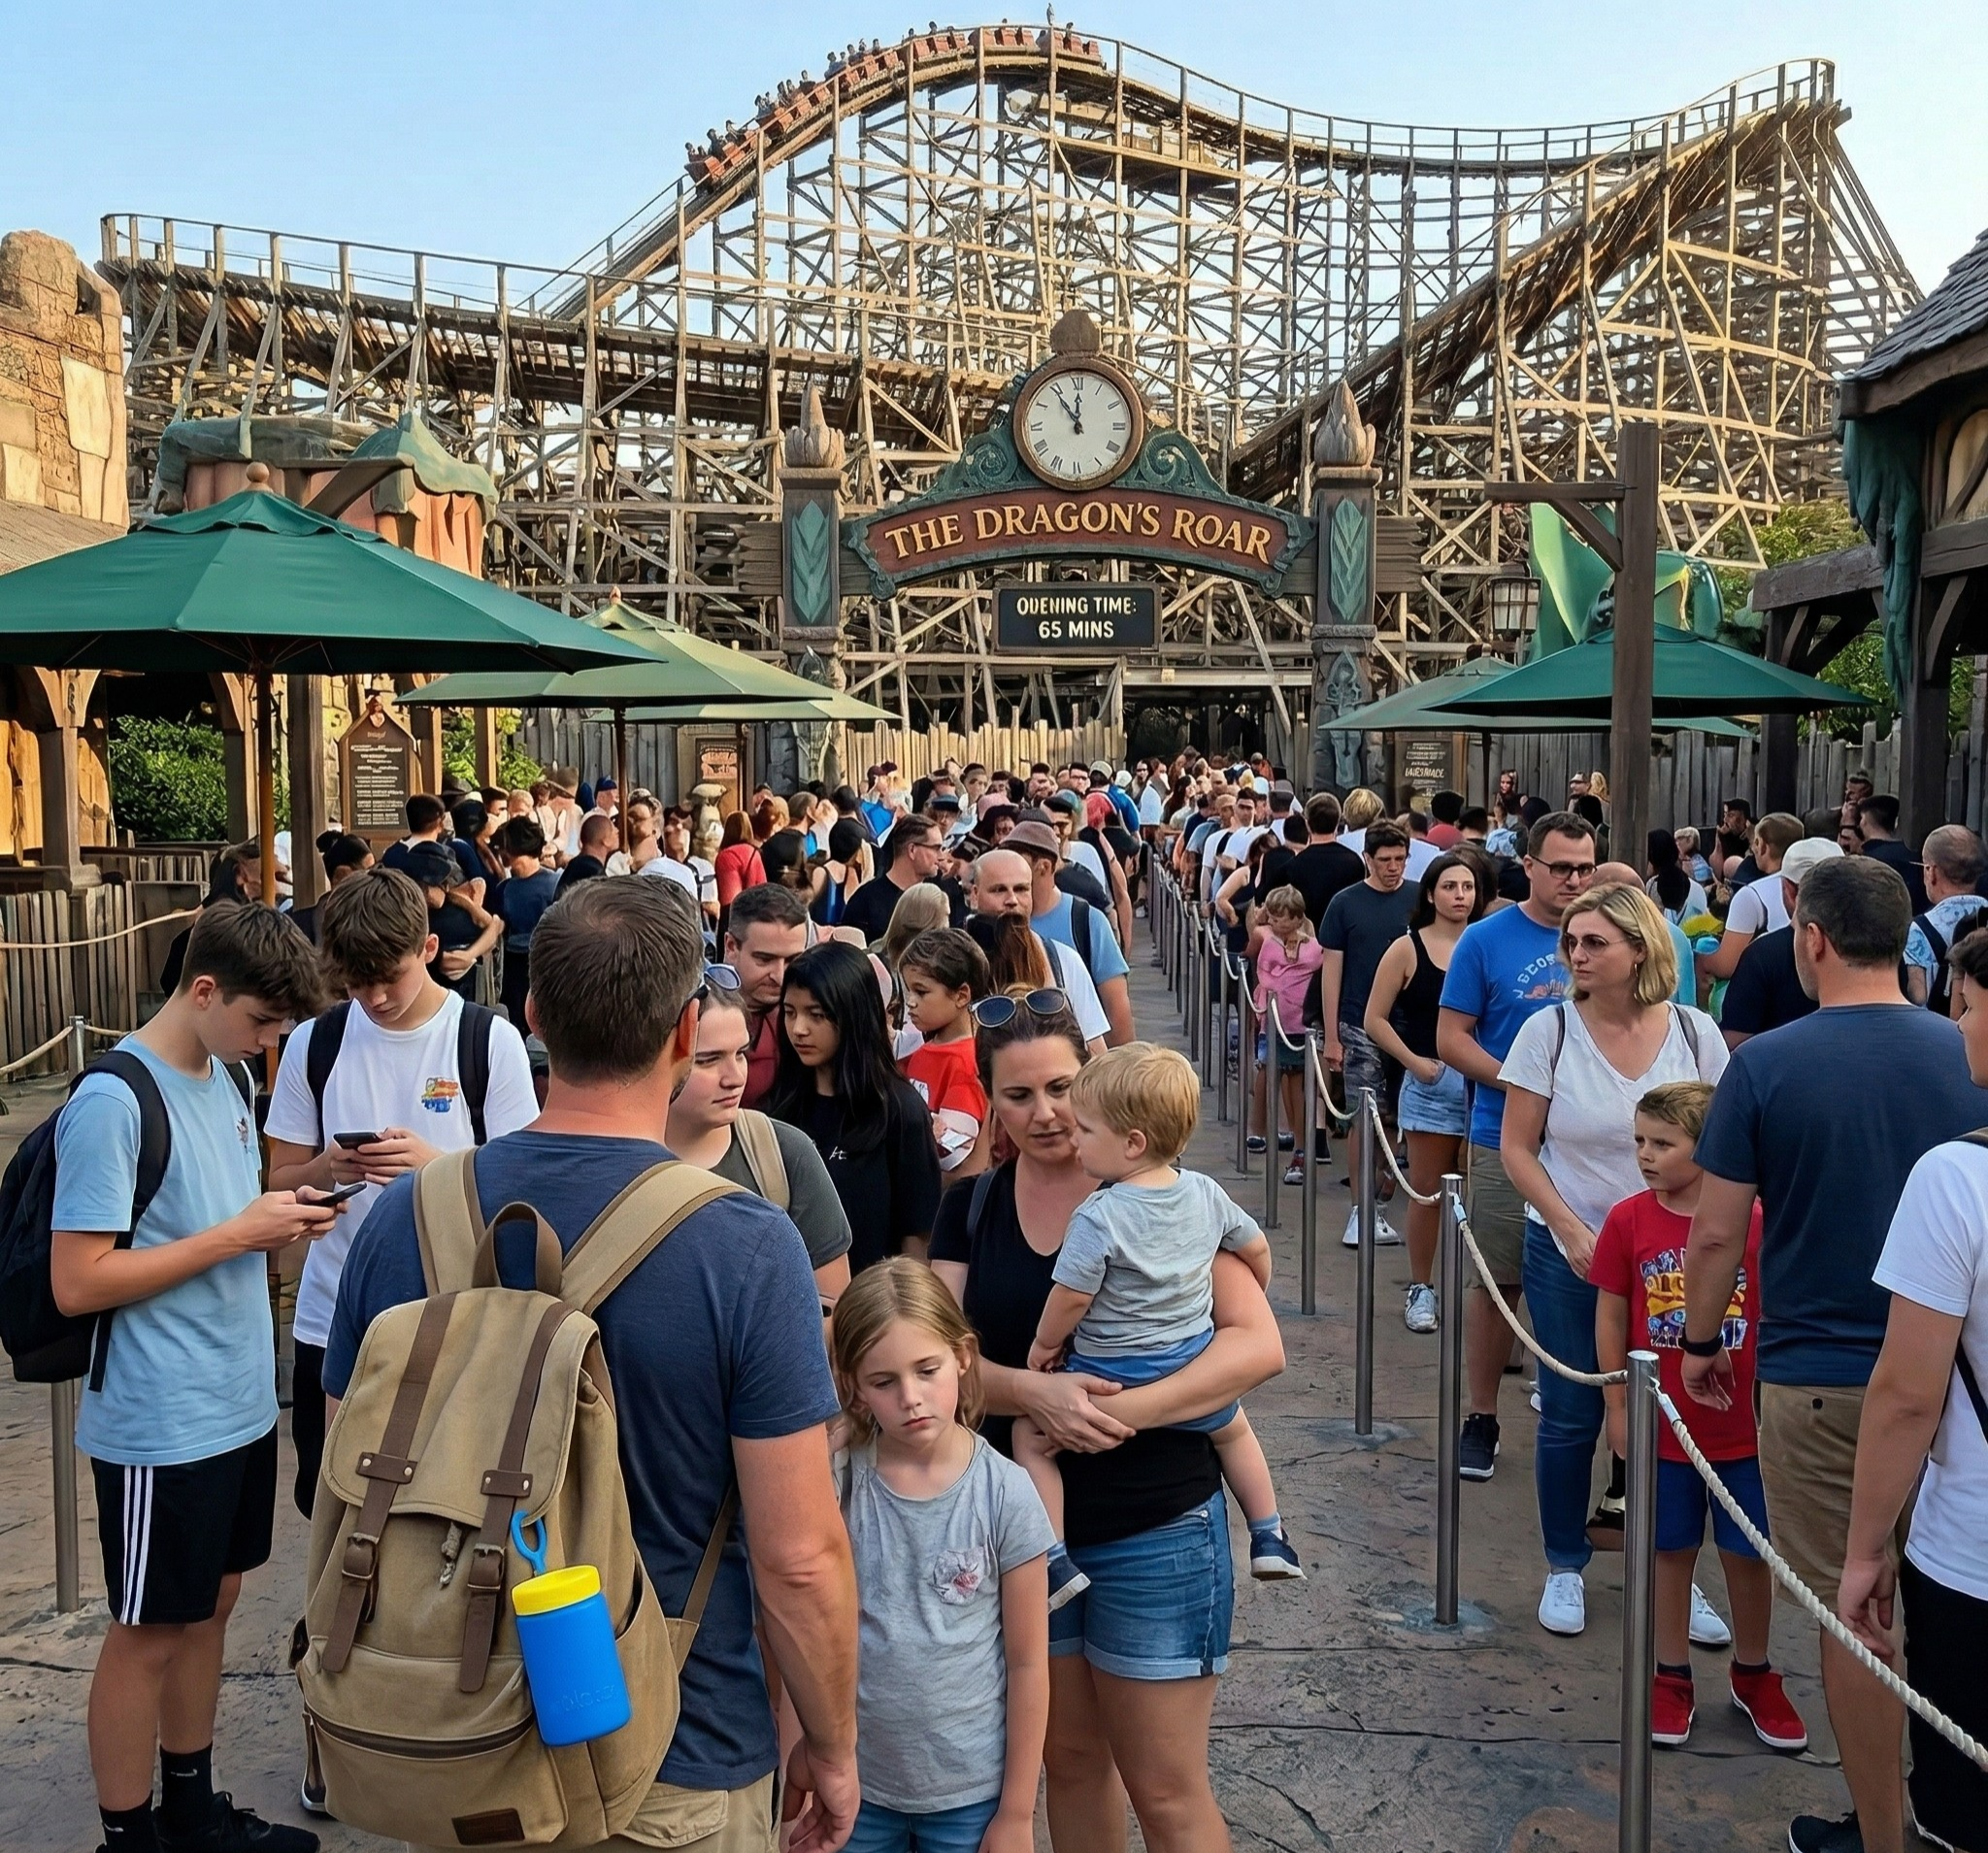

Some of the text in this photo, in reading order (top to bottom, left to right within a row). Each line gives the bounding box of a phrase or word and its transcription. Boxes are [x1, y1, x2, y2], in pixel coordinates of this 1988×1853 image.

[885, 502, 1271, 565] THE DRAGON'S ROAR
[1094, 597, 1137, 614] TIME:
[1039, 621, 1114, 639] 65 MINS
